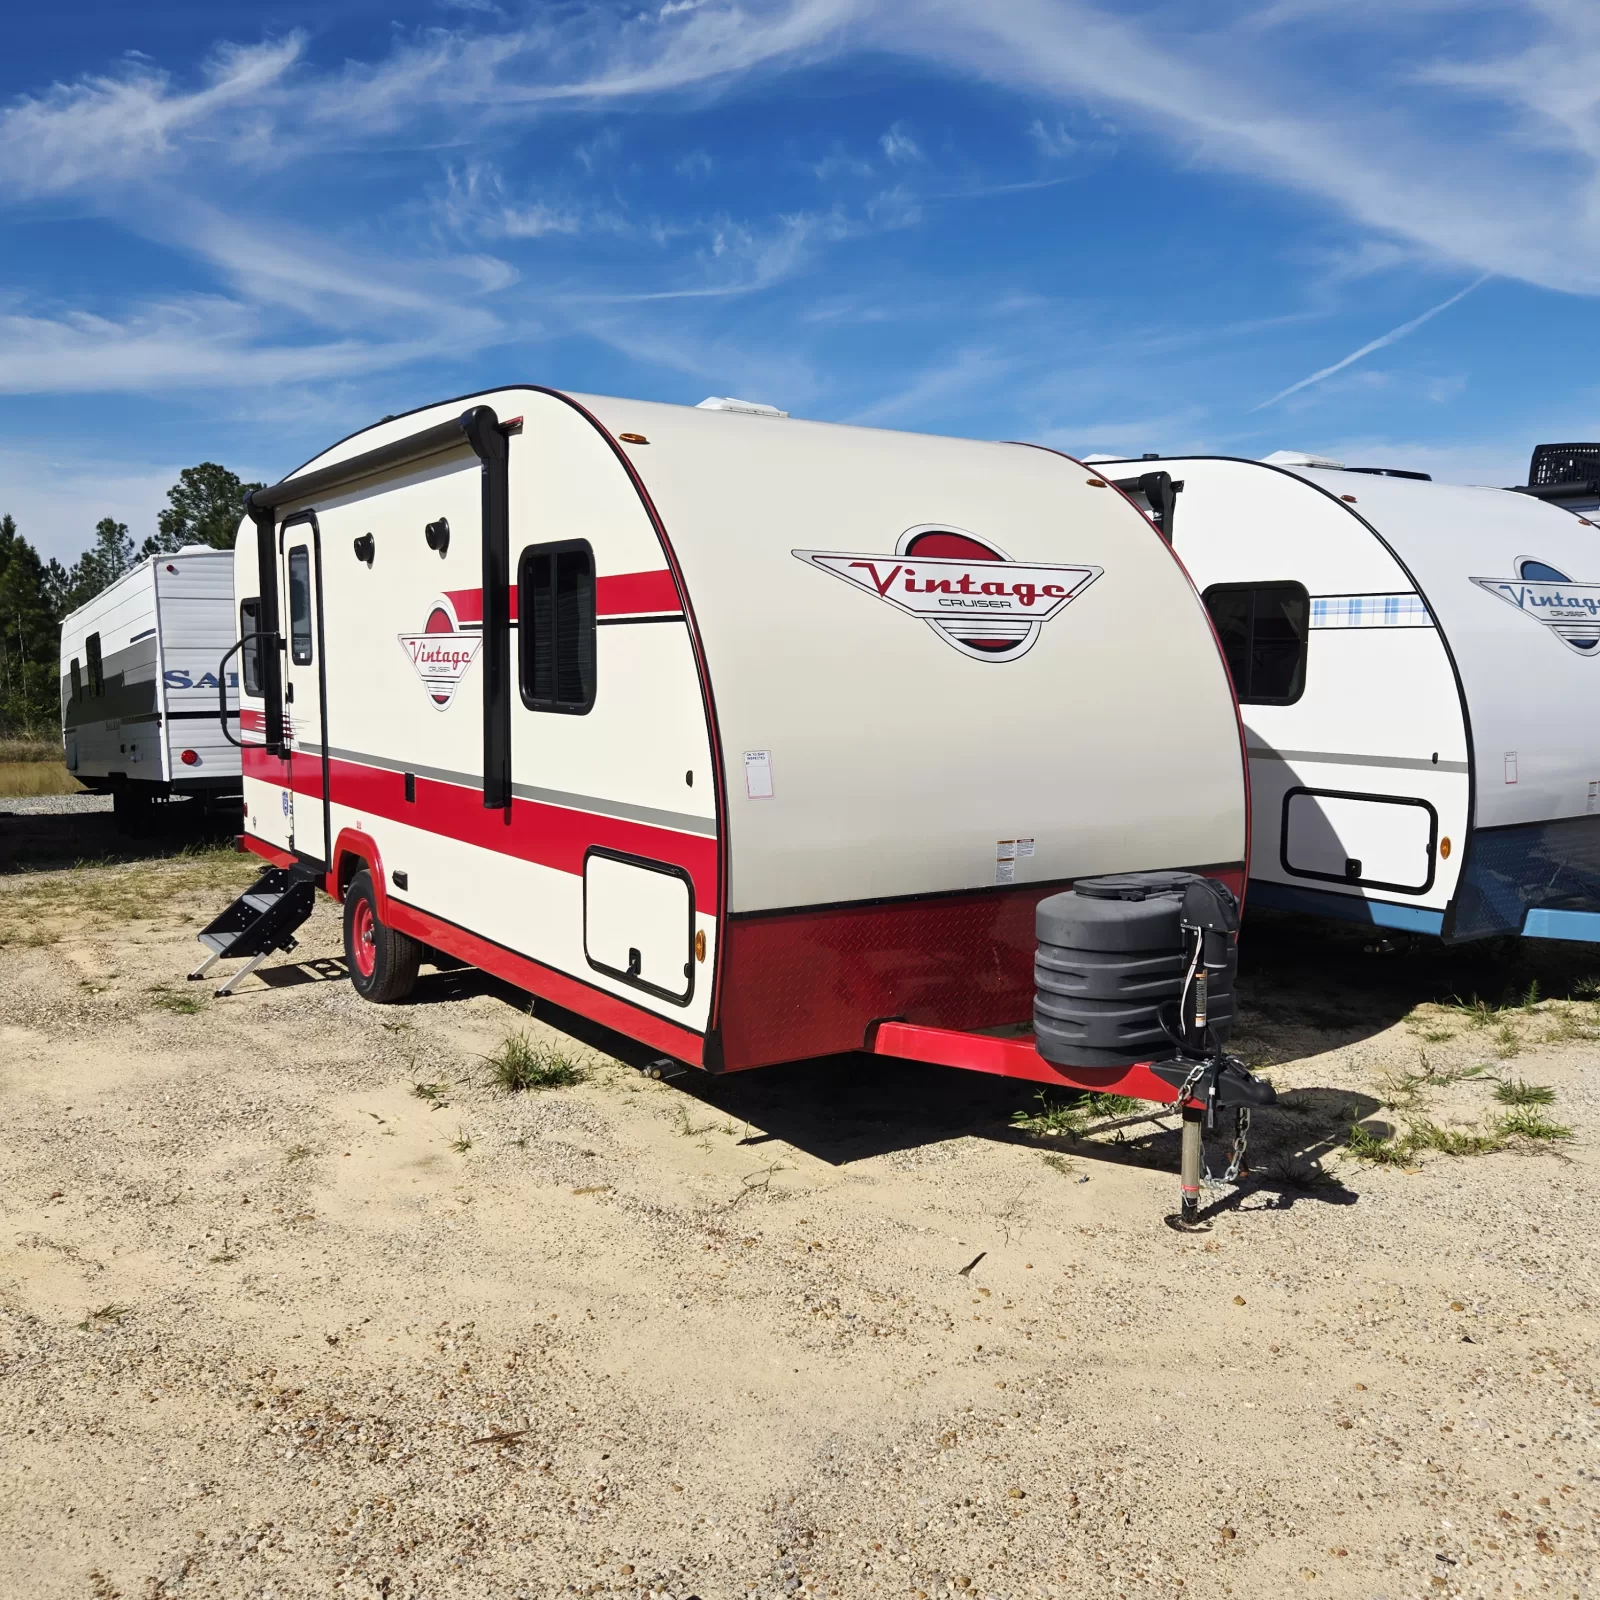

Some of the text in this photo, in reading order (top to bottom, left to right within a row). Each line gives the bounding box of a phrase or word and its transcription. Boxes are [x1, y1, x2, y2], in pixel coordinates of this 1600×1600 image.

[848, 562, 1073, 607] Vintage
[938, 598, 1012, 609] CRUISER
[1498, 585, 1600, 615] Vintag
[409, 641, 471, 670] Vintage
